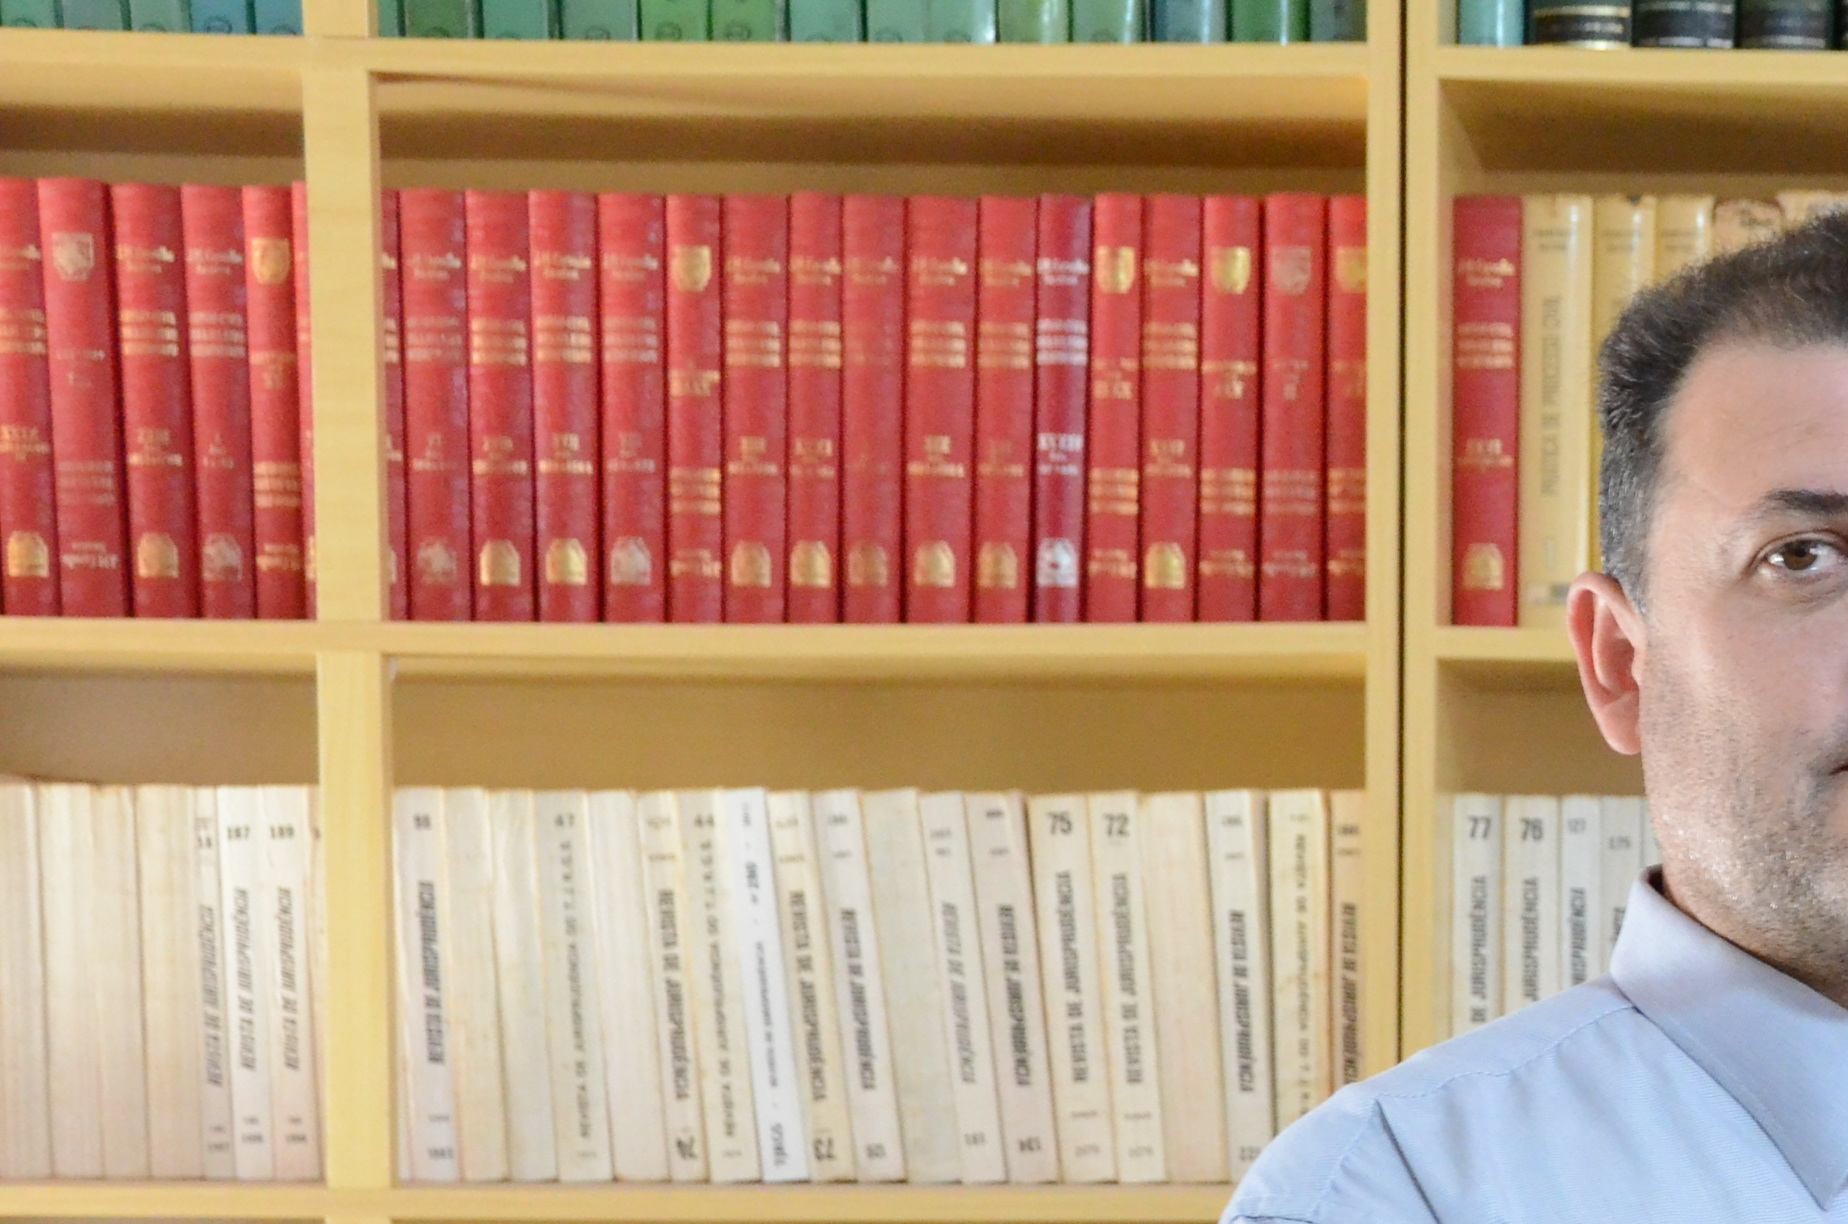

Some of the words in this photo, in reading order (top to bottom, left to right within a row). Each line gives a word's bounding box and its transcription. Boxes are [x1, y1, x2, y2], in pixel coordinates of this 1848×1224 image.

[1047, 811, 1073, 836] 75
[1103, 813, 1130, 838] 72
[1468, 816, 1492, 840] 77
